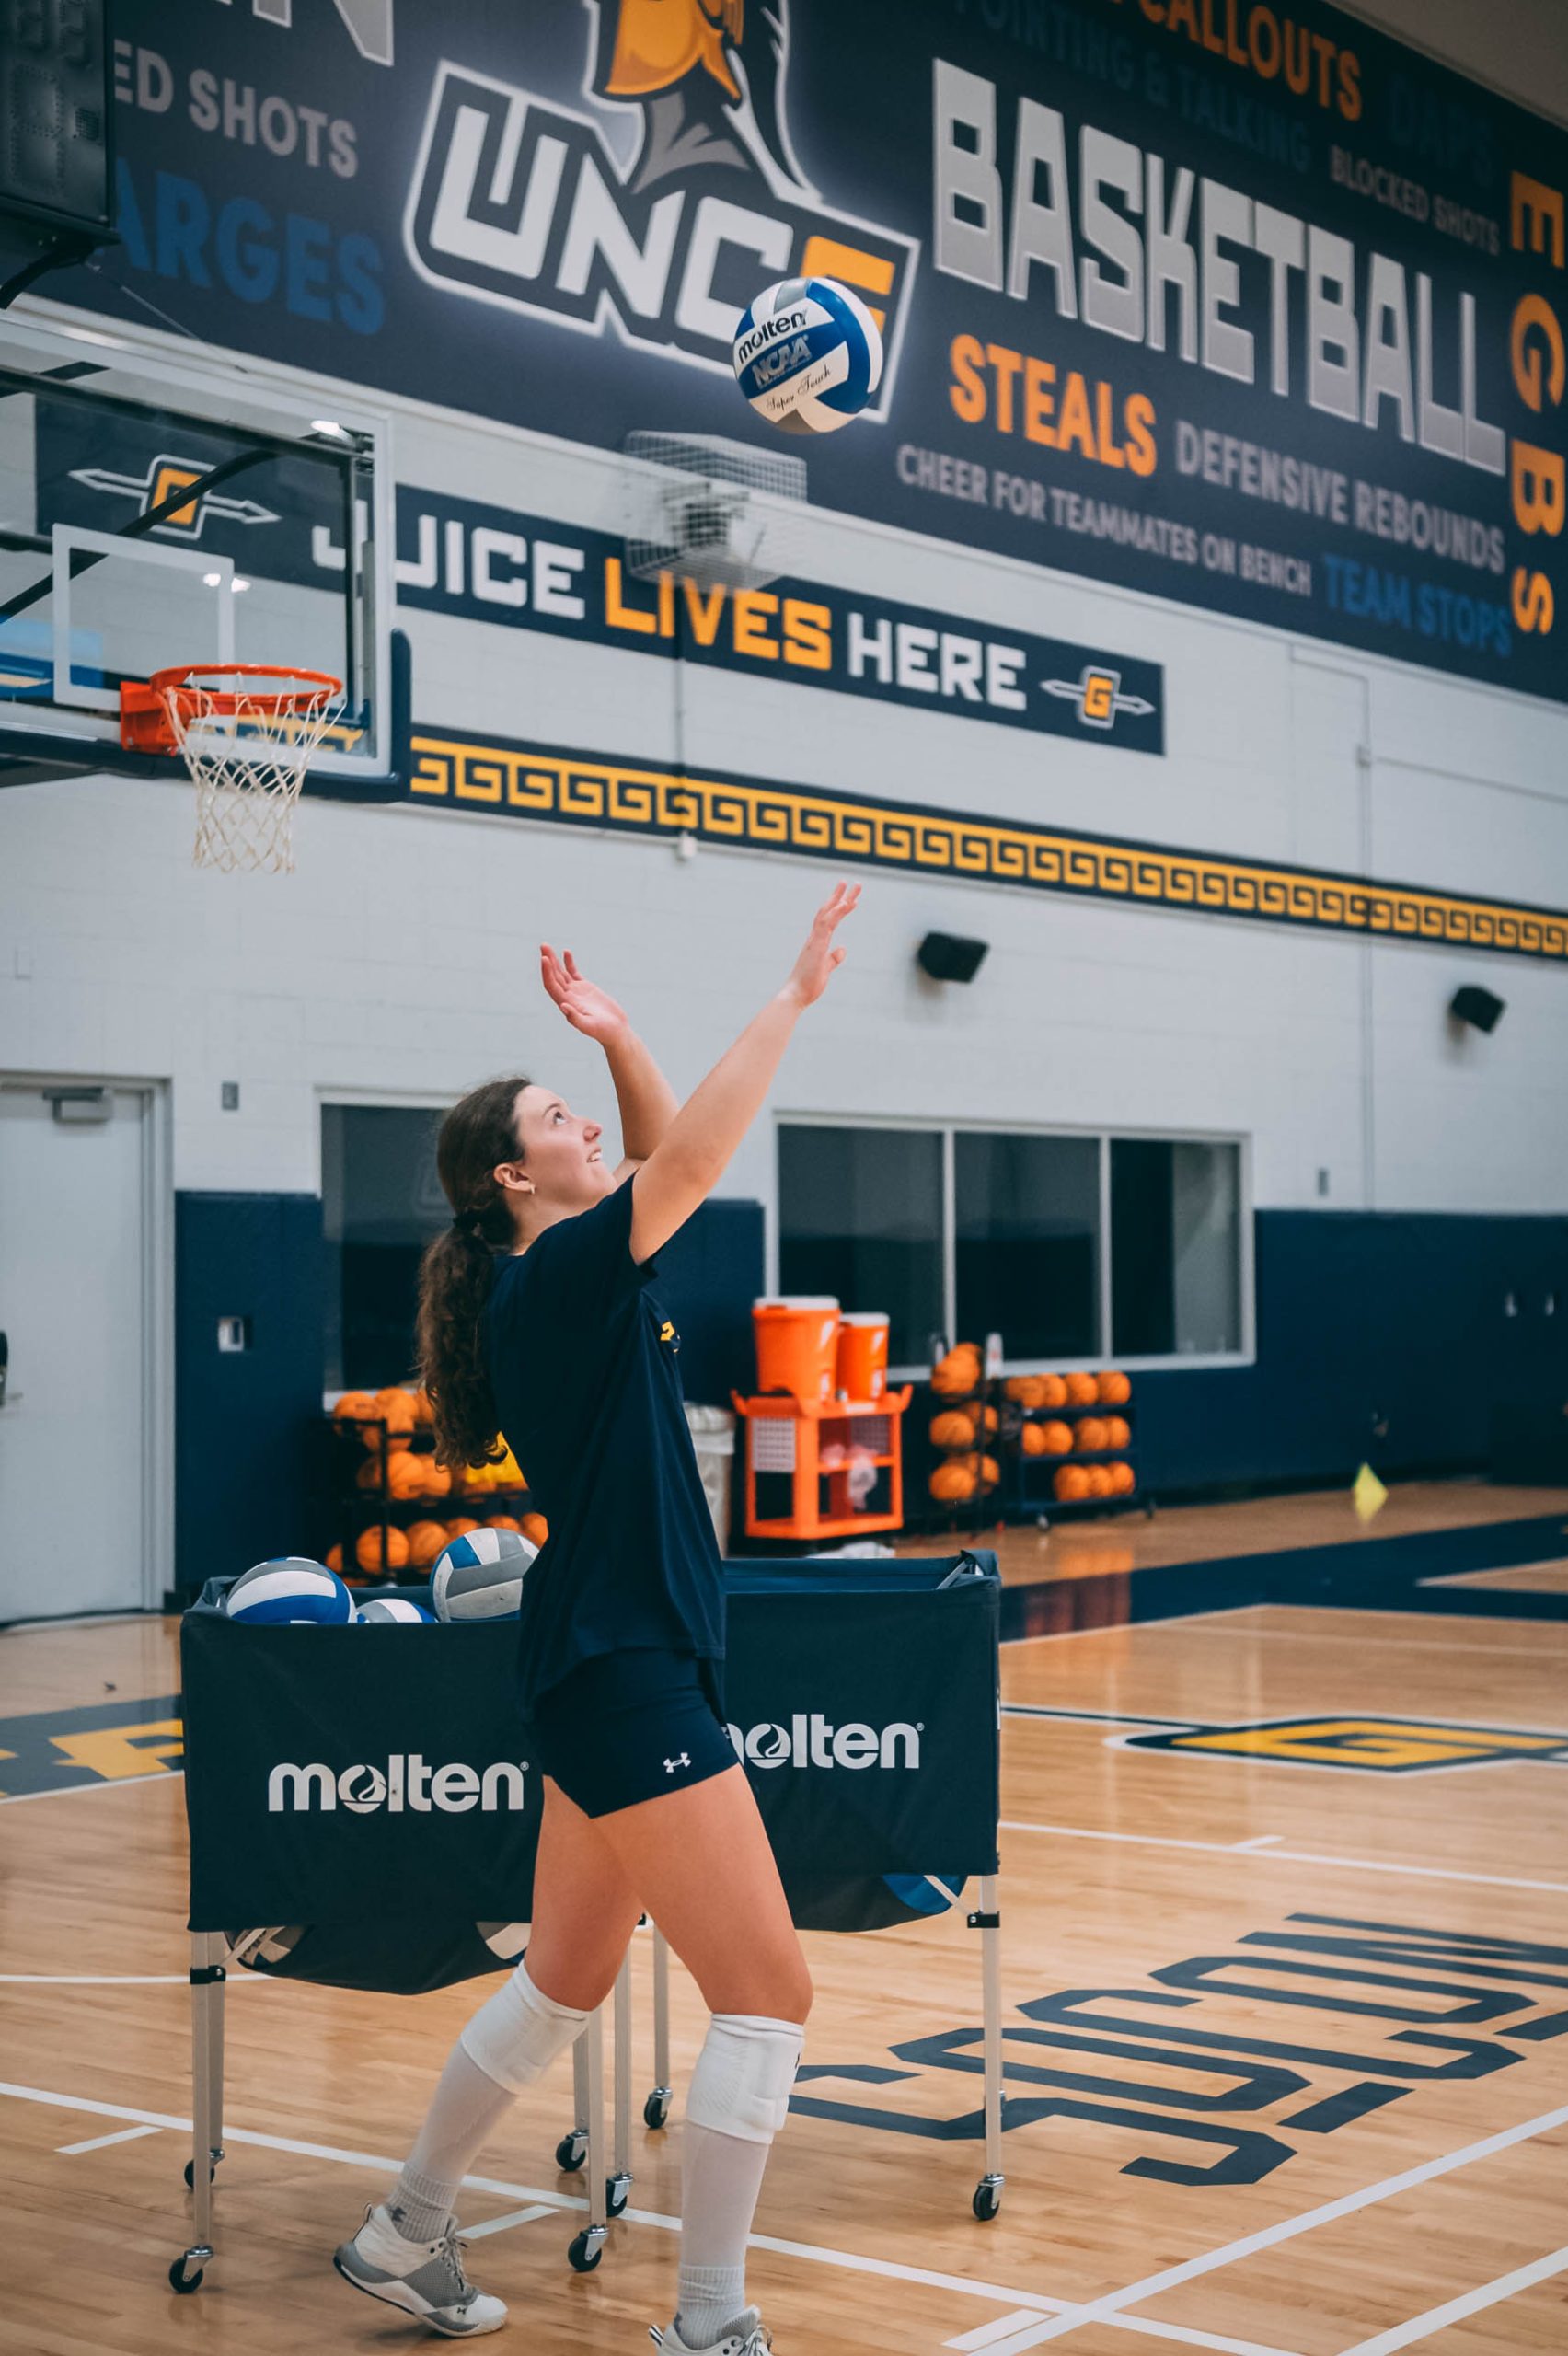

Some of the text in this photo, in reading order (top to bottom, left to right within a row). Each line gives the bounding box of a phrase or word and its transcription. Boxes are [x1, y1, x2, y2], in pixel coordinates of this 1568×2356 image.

[954, 0, 1135, 92] OINTING
[189, 68, 358, 179] SHOTS
[1332, 144, 1500, 256] BLOCKED SHOTS
[931, 56, 1506, 477] BASKETBALL
[738, 311, 808, 365] molten
[751, 336, 813, 391] NCAA
[766, 363, 832, 411] Super Touch
[949, 333, 1158, 477] STEALS
[896, 443, 1312, 596] CHEER FOR TEAMMATES ON BENCH
[1174, 419, 1505, 575] DEFENSIVE REBOUNDS
[604, 557, 833, 671] LIVES
[847, 612, 1028, 711] HERE
[1323, 553, 1512, 656] TEAM STOPS
[268, 1753, 525, 1814] molten
[721, 1714, 920, 1770] olten
